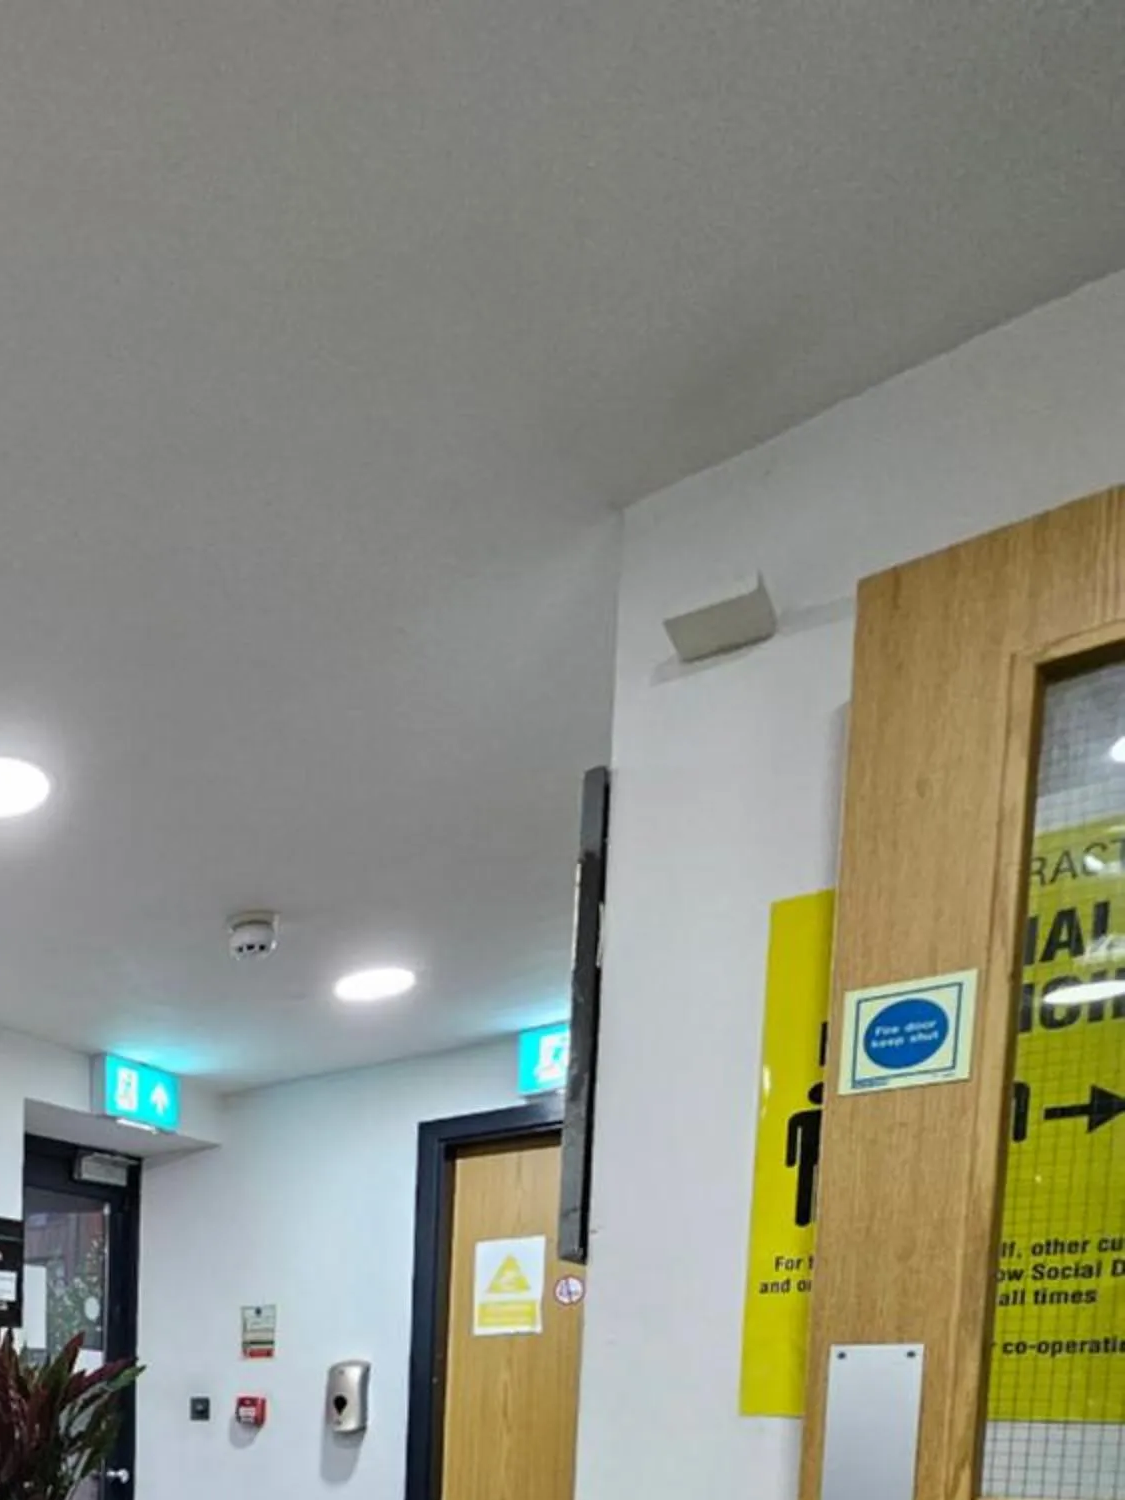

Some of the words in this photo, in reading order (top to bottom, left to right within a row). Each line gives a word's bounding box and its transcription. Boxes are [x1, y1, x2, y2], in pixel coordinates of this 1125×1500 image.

[904, 1019, 937, 1032] door
[871, 1036, 904, 1049] keep
[910, 1031, 939, 1043] shut
[1031, 1238, 1091, 1257] other
[775, 1255, 804, 1272] For
[1032, 1260, 1102, 1281] Social
[759, 1279, 791, 1294] and
[998, 1288, 1025, 1307] all
[1033, 1287, 1098, 1306] times
